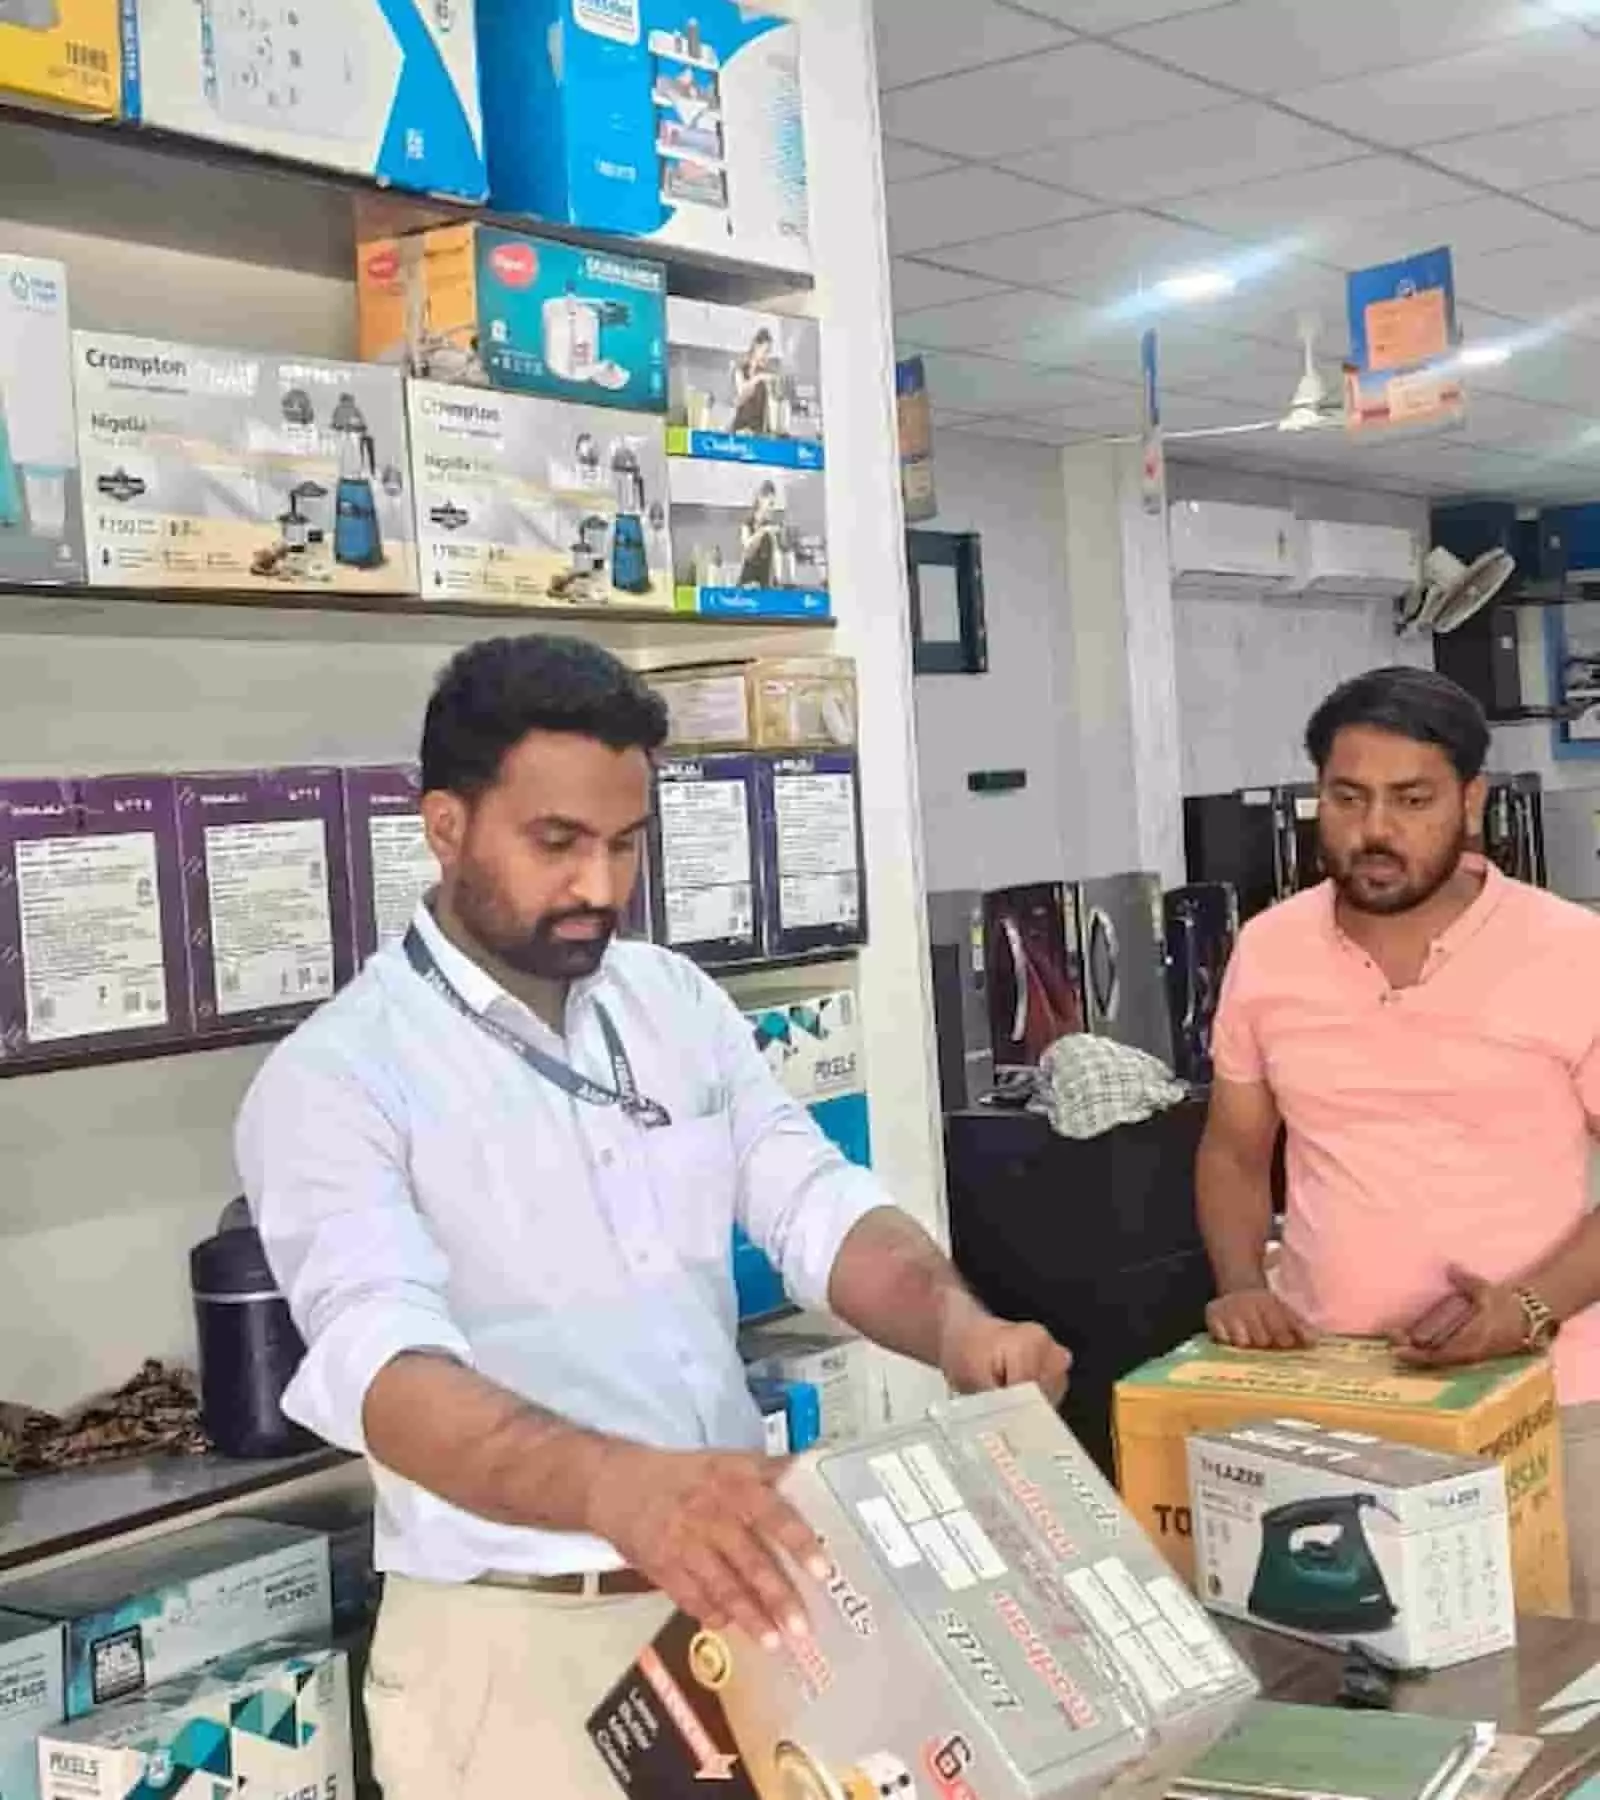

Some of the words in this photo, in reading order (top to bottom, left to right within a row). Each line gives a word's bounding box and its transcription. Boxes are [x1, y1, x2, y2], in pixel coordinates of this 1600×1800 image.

[86, 348, 188, 379] Crompton
[421, 399, 501, 425] Crompton
[814, 1053, 857, 1079] PIXELS
[828, 1567, 878, 1638] rds
[941, 1610, 1024, 1711] Lords
[49, 1751, 98, 1777] PIXELS
